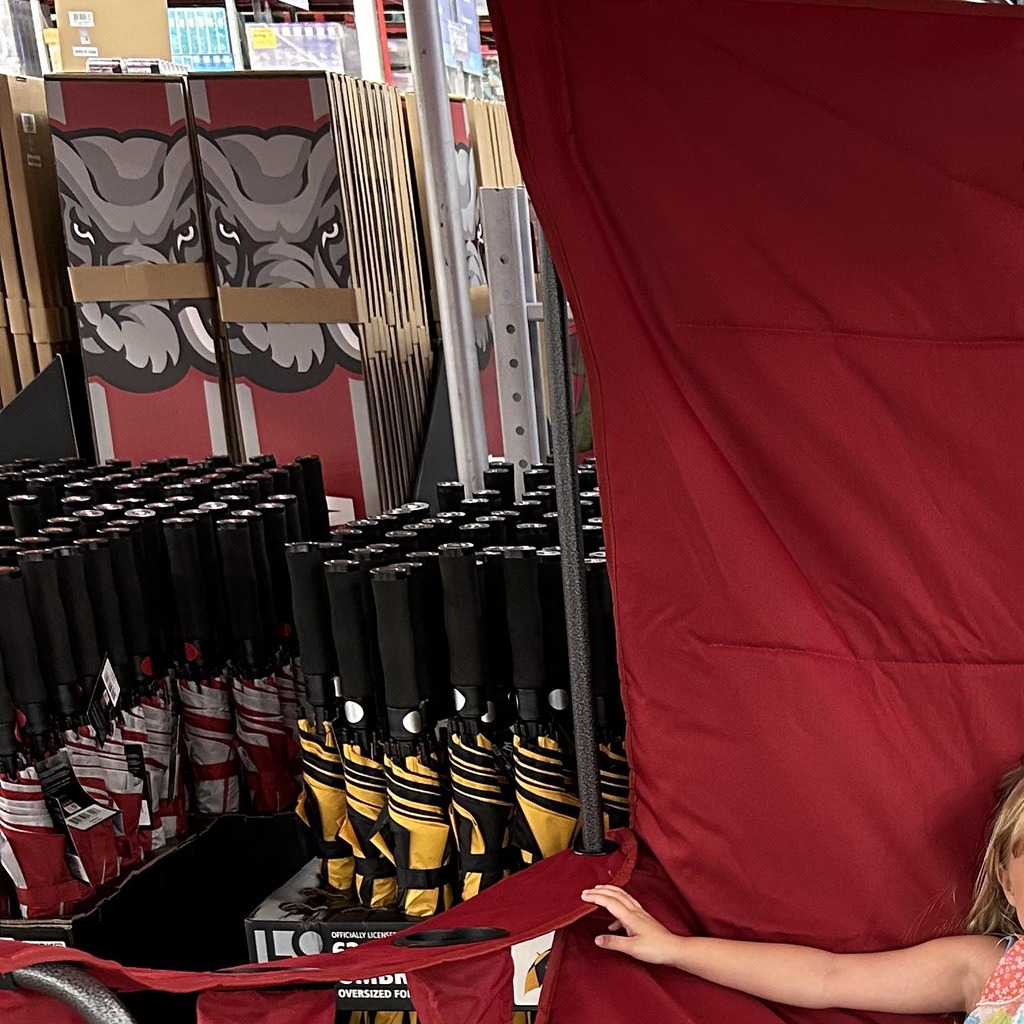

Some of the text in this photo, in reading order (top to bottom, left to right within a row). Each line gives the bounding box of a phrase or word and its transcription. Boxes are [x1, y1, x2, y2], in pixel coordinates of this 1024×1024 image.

[331, 931, 396, 939] OFFICIALLY LICENS
[338, 989, 392, 999] OVERSIZED
